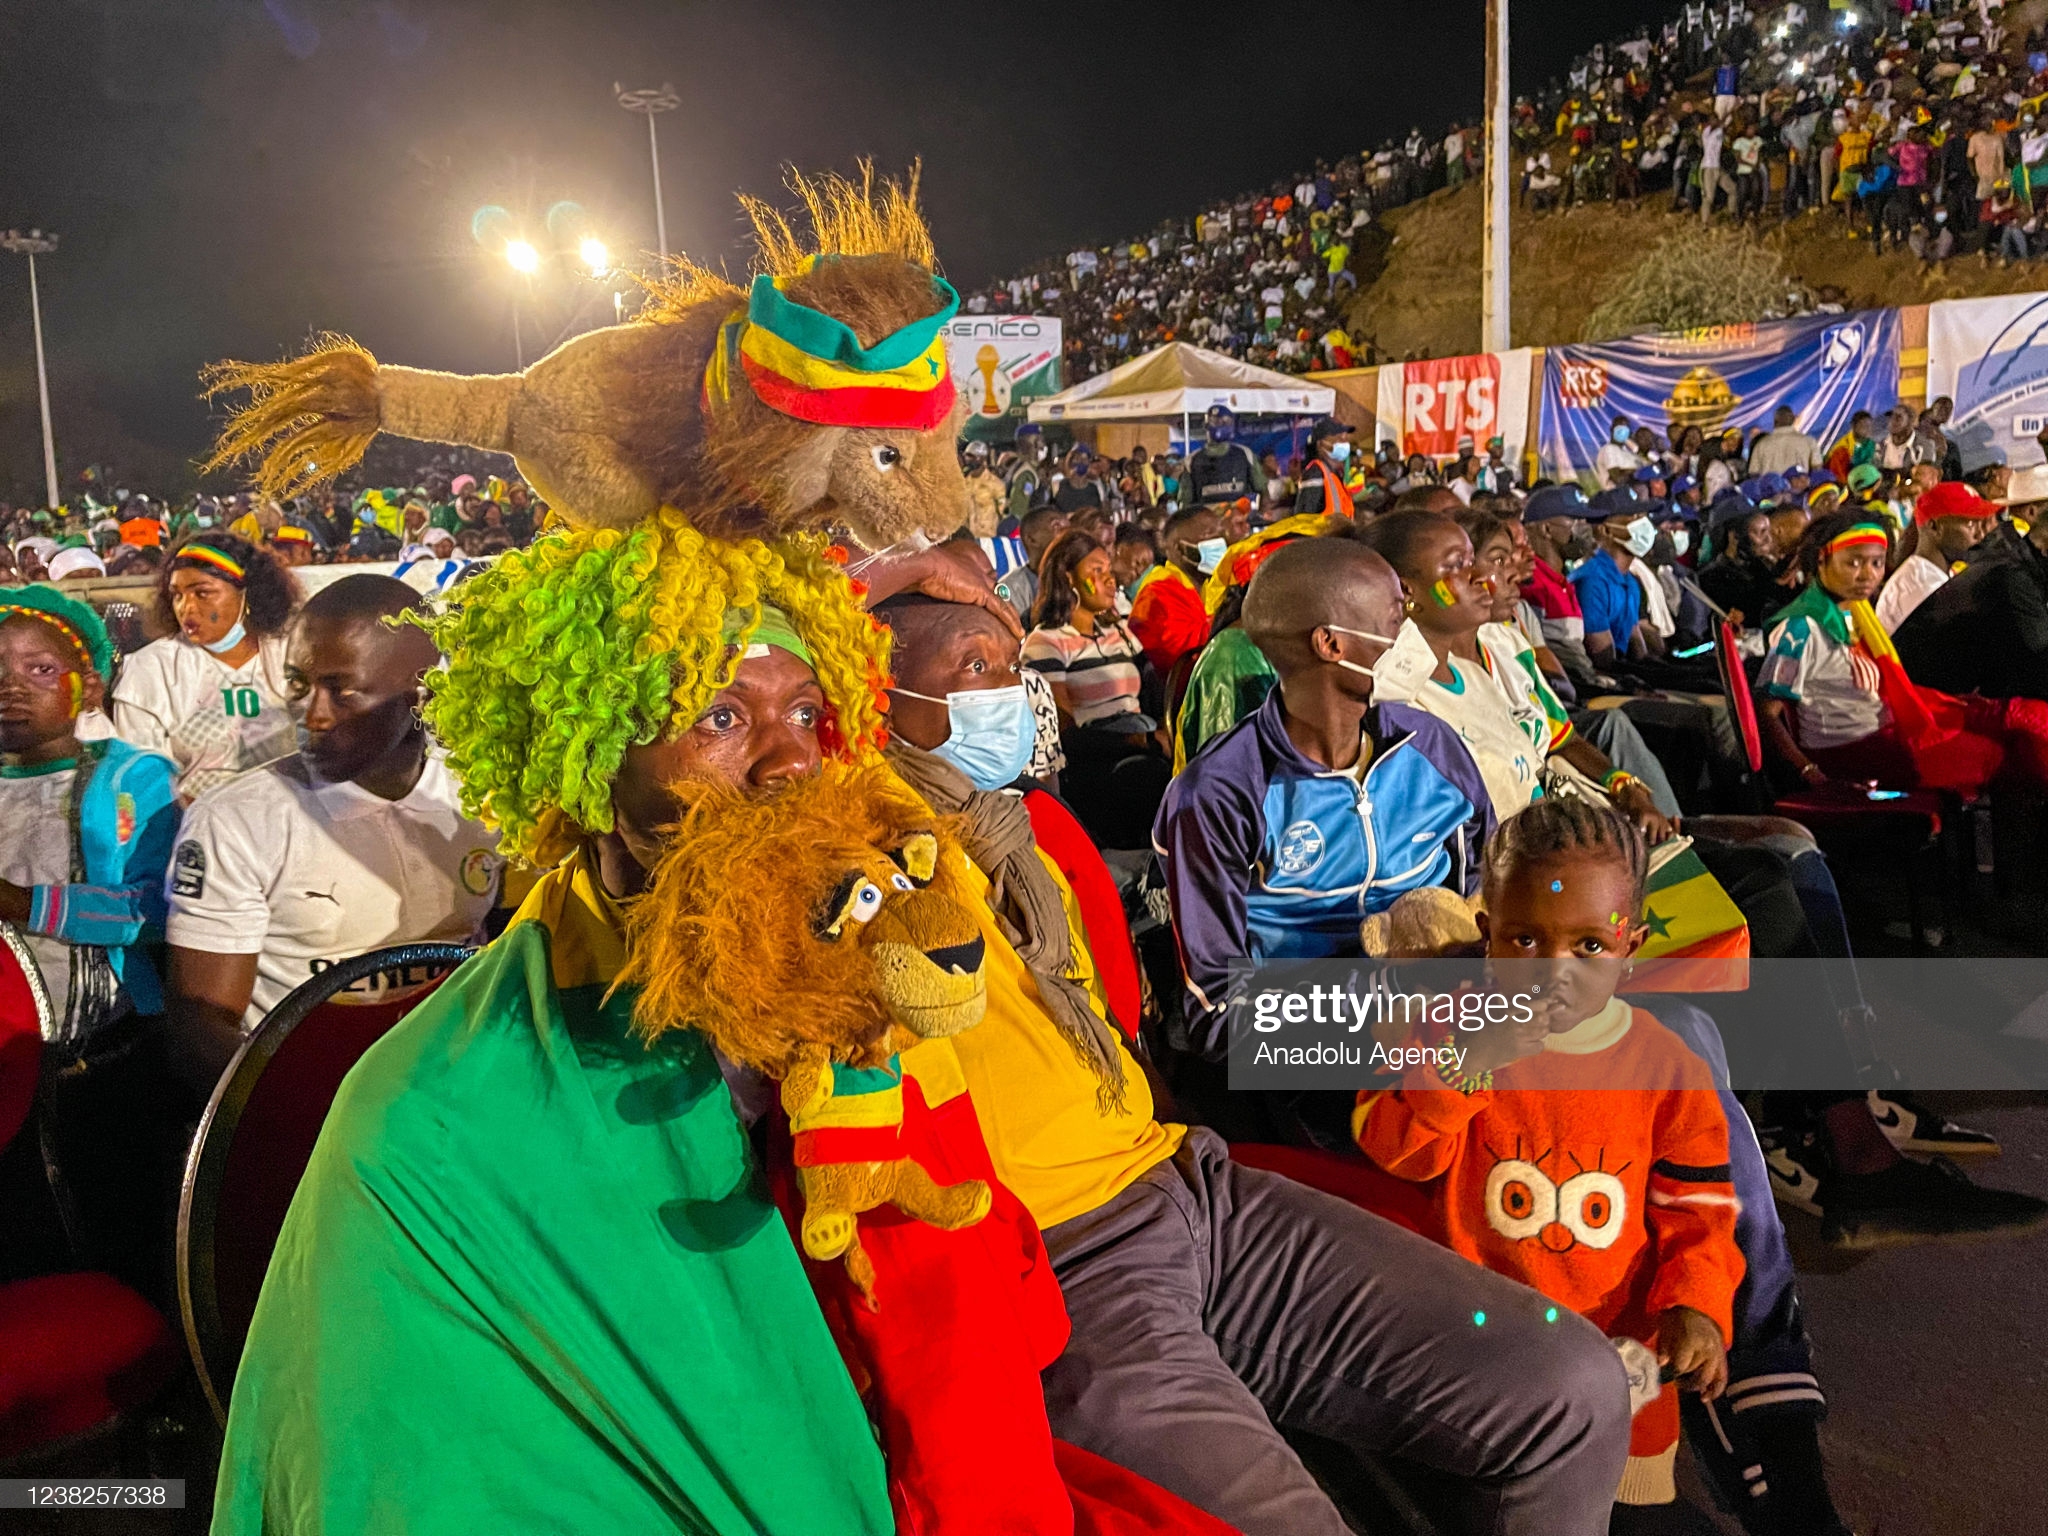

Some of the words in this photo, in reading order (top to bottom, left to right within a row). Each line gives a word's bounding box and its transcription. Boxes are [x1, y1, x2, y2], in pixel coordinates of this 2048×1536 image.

[1565, 366, 1603, 392] RTS
[1405, 376, 1495, 433] RTS
[2021, 418, 2039, 431] Un
[220, 687, 261, 718] 10
